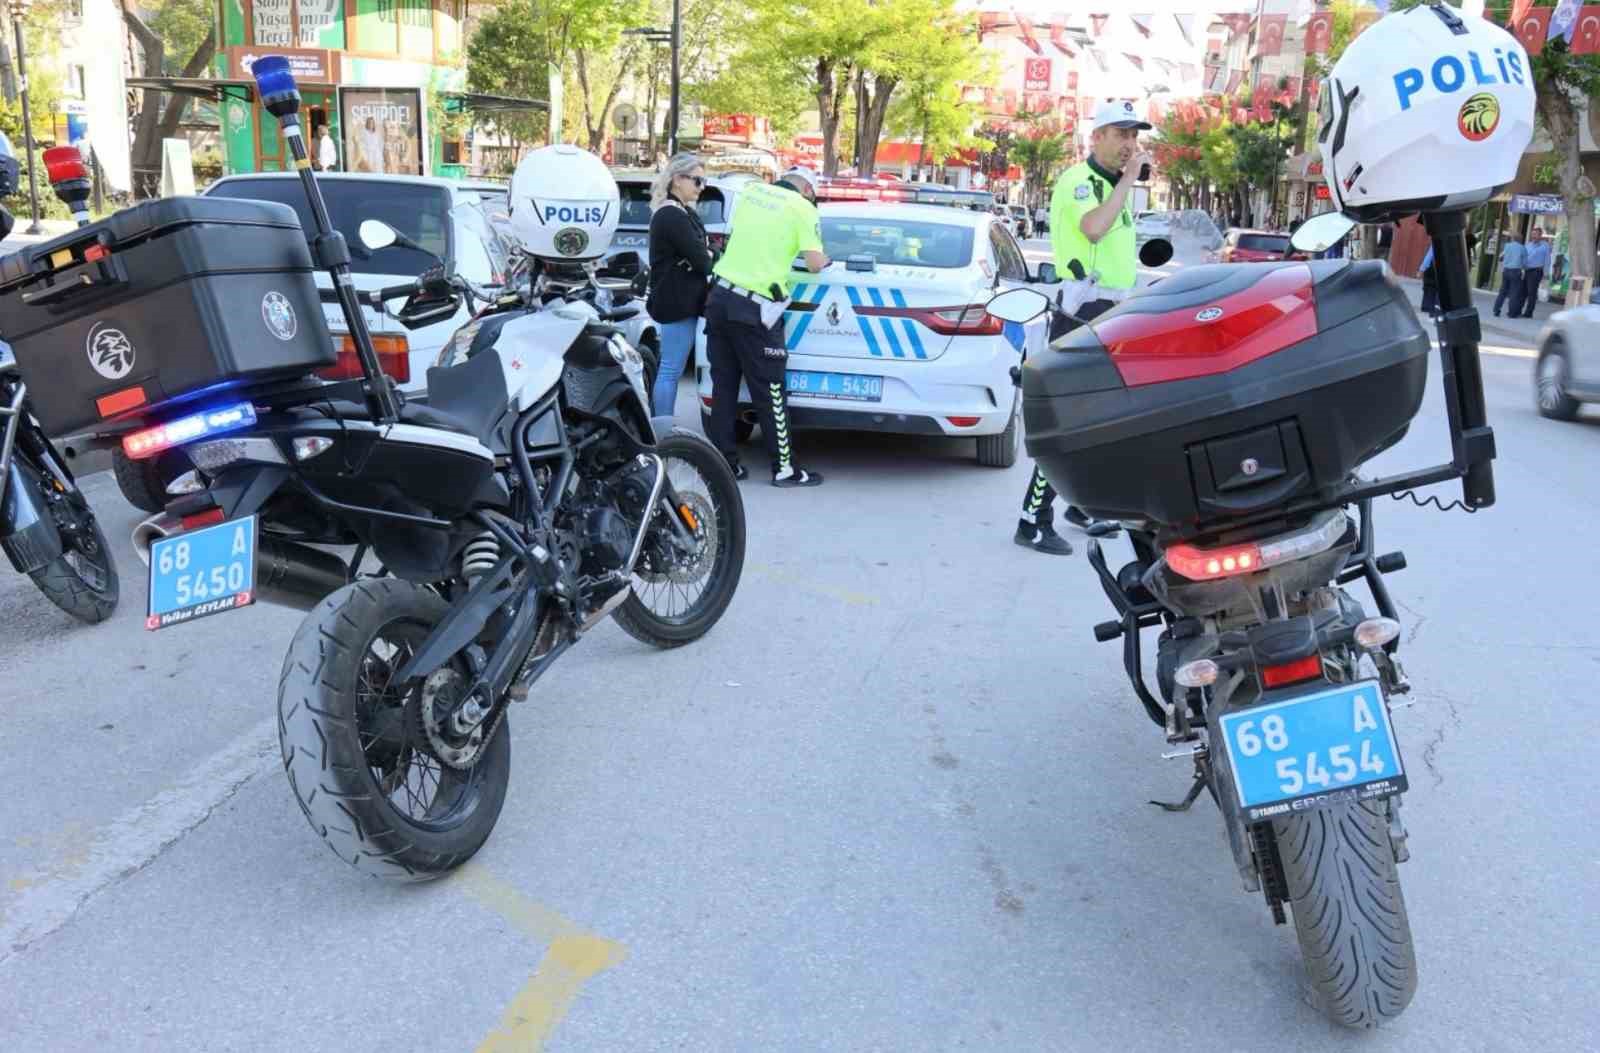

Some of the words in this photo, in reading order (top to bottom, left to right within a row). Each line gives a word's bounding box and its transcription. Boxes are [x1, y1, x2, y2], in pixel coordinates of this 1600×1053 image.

[790, 374, 808, 389] 68
[820, 375, 829, 392] A
[842, 376, 880, 395] 5430
[159, 541, 190, 575] 68
[231, 525, 245, 557] A
[176, 561, 244, 605] 5450
[1236, 714, 1288, 757] 68
[1353, 695, 1377, 733] A
[1275, 740, 1385, 794] 5454
